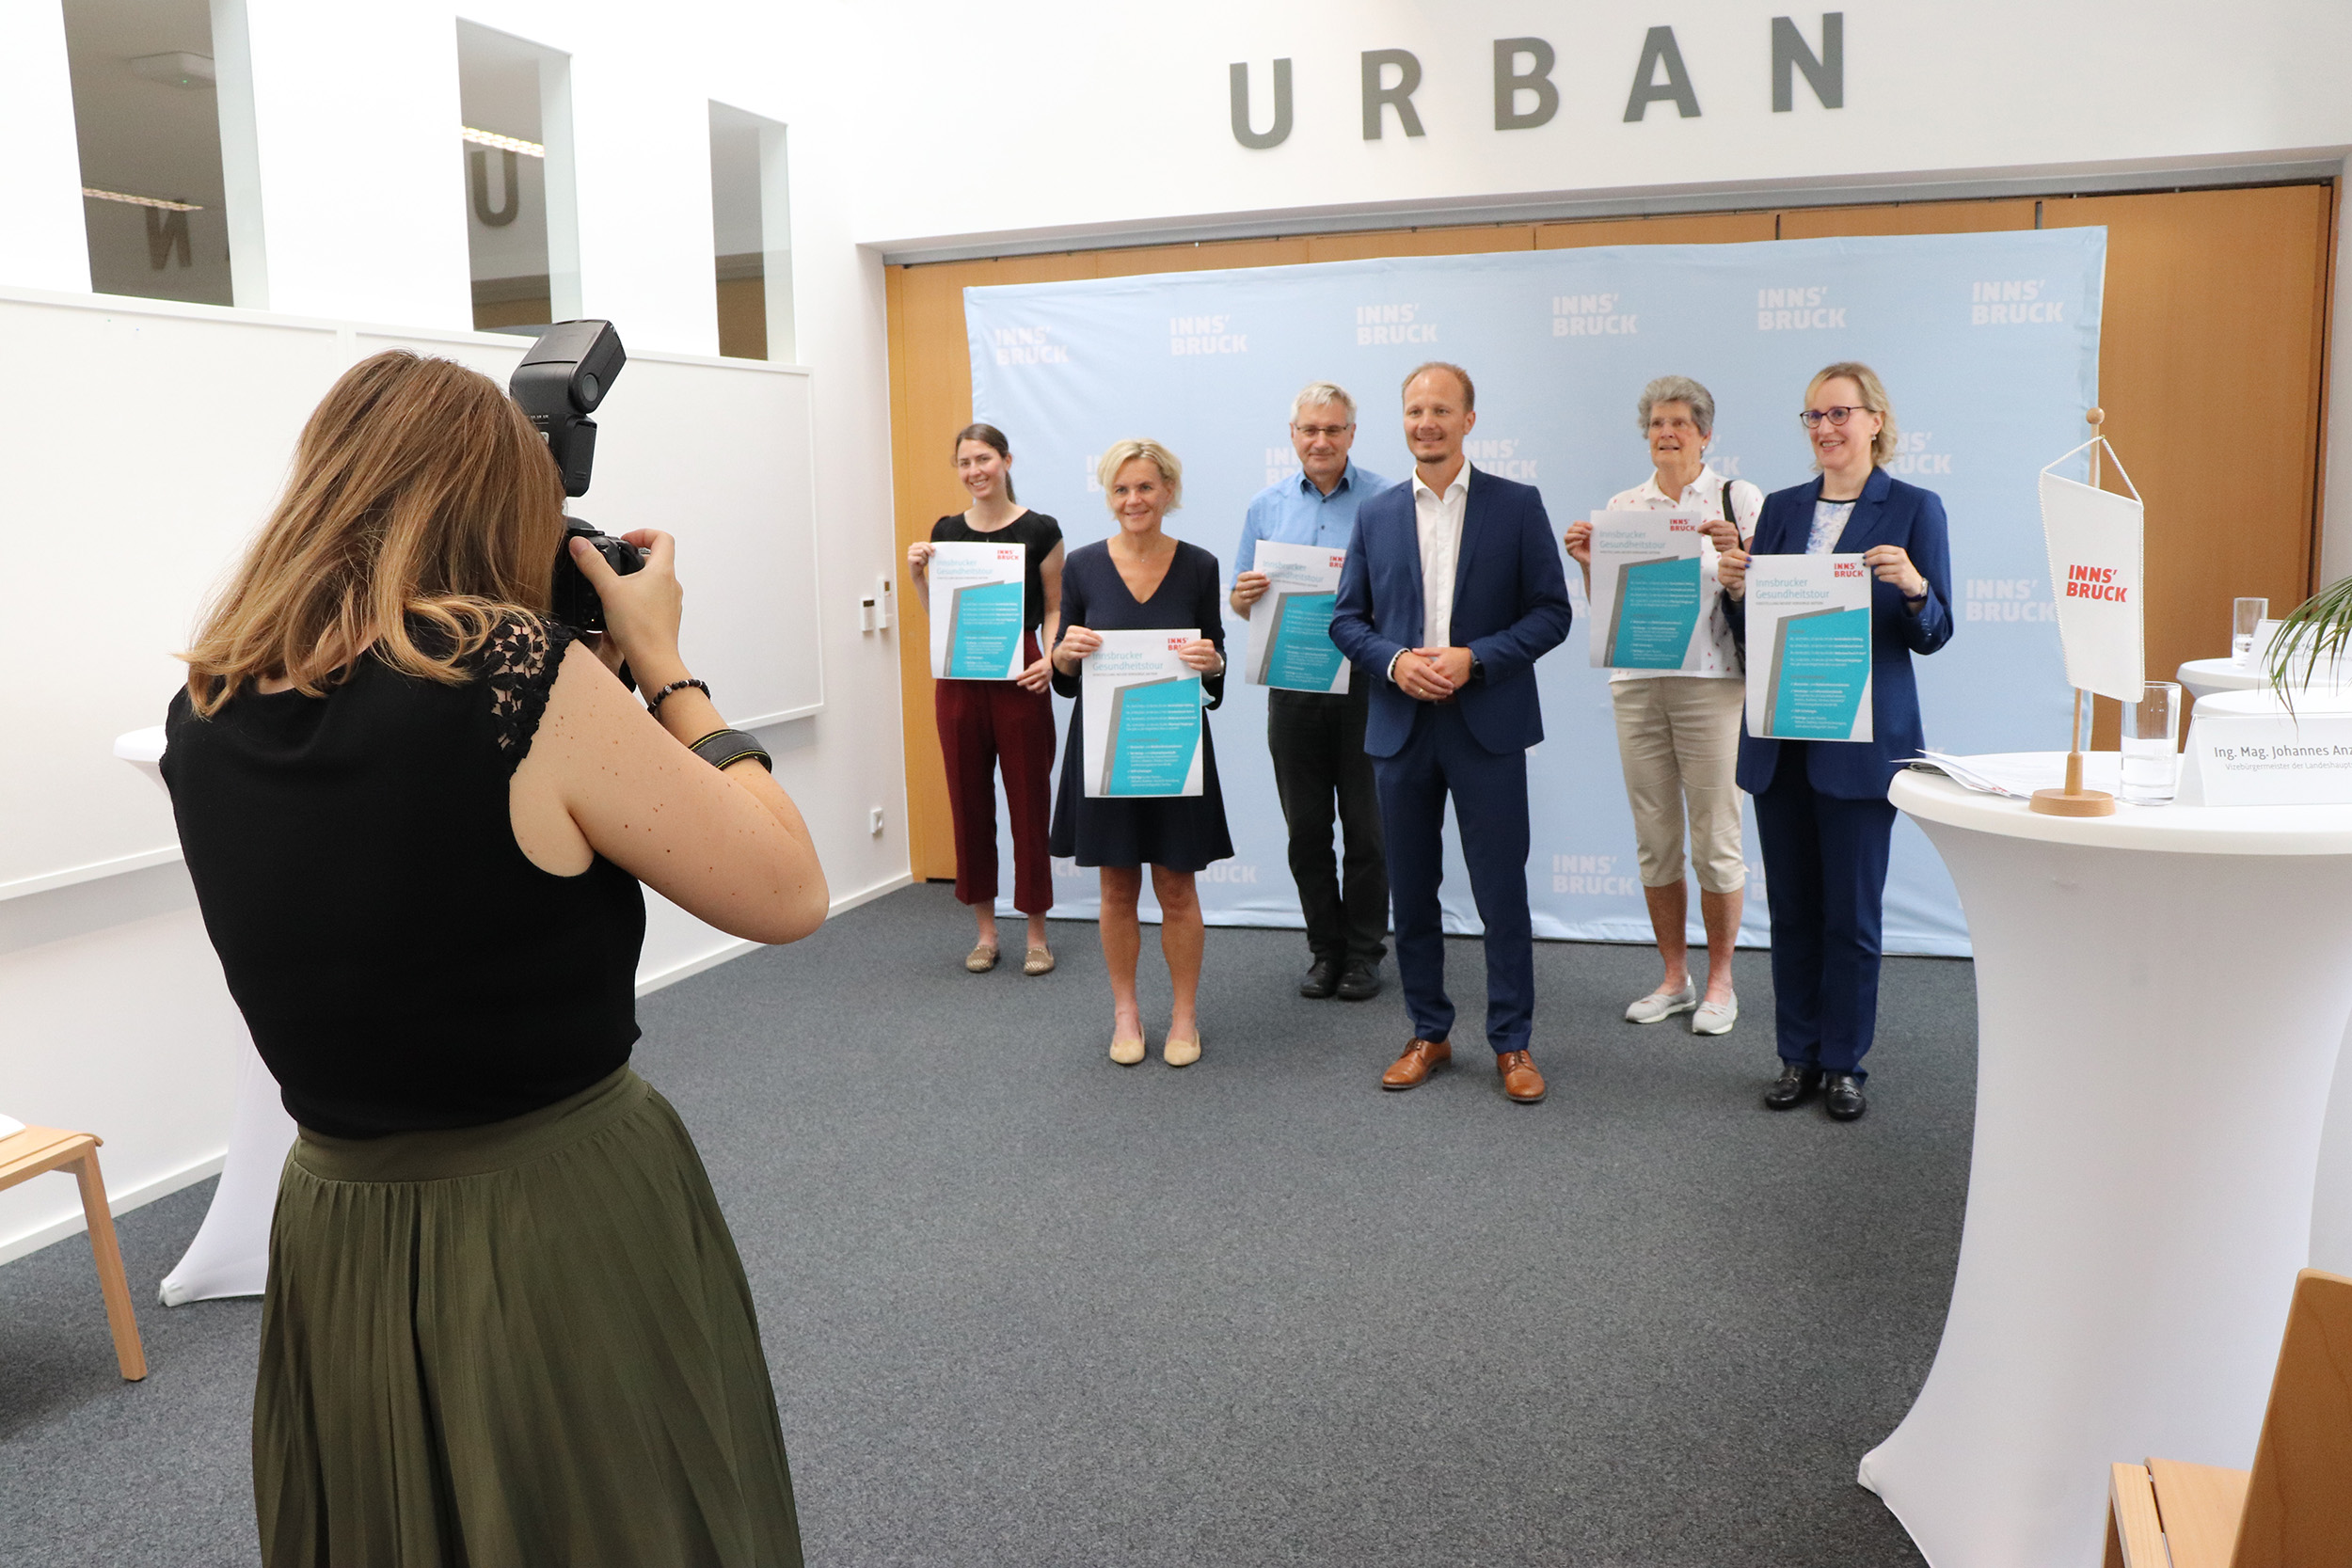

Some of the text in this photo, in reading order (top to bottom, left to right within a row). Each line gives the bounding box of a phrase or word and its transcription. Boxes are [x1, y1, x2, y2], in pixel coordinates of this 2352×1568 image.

[1758, 309, 1847, 329] BRUCK
[1972, 301, 2064, 325] BRUCK
[1357, 324, 1438, 345] BRUCK
[1552, 314, 1638, 337] BRUCK
[1170, 333, 1248, 356] BRUCK
[995, 345, 1070, 365] BRUCK
[1756, 578, 1807, 587] Innsbrucker
[2066, 581, 2128, 602] BRUCK
[1756, 589, 1830, 599] Gesundheitstour
[1966, 601, 2057, 622] BRUCK
[1091, 651, 1143, 660] Innsbrucker
[1091, 661, 1164, 671] Gesundheitstour
[2214, 747, 2237, 760] Ing.
[2240, 746, 2268, 760] Mag.
[2271, 744, 2329, 759] Johannes
[2225, 762, 2290, 772] Vizebürgermeister
[1552, 874, 1635, 895] BRUCK
